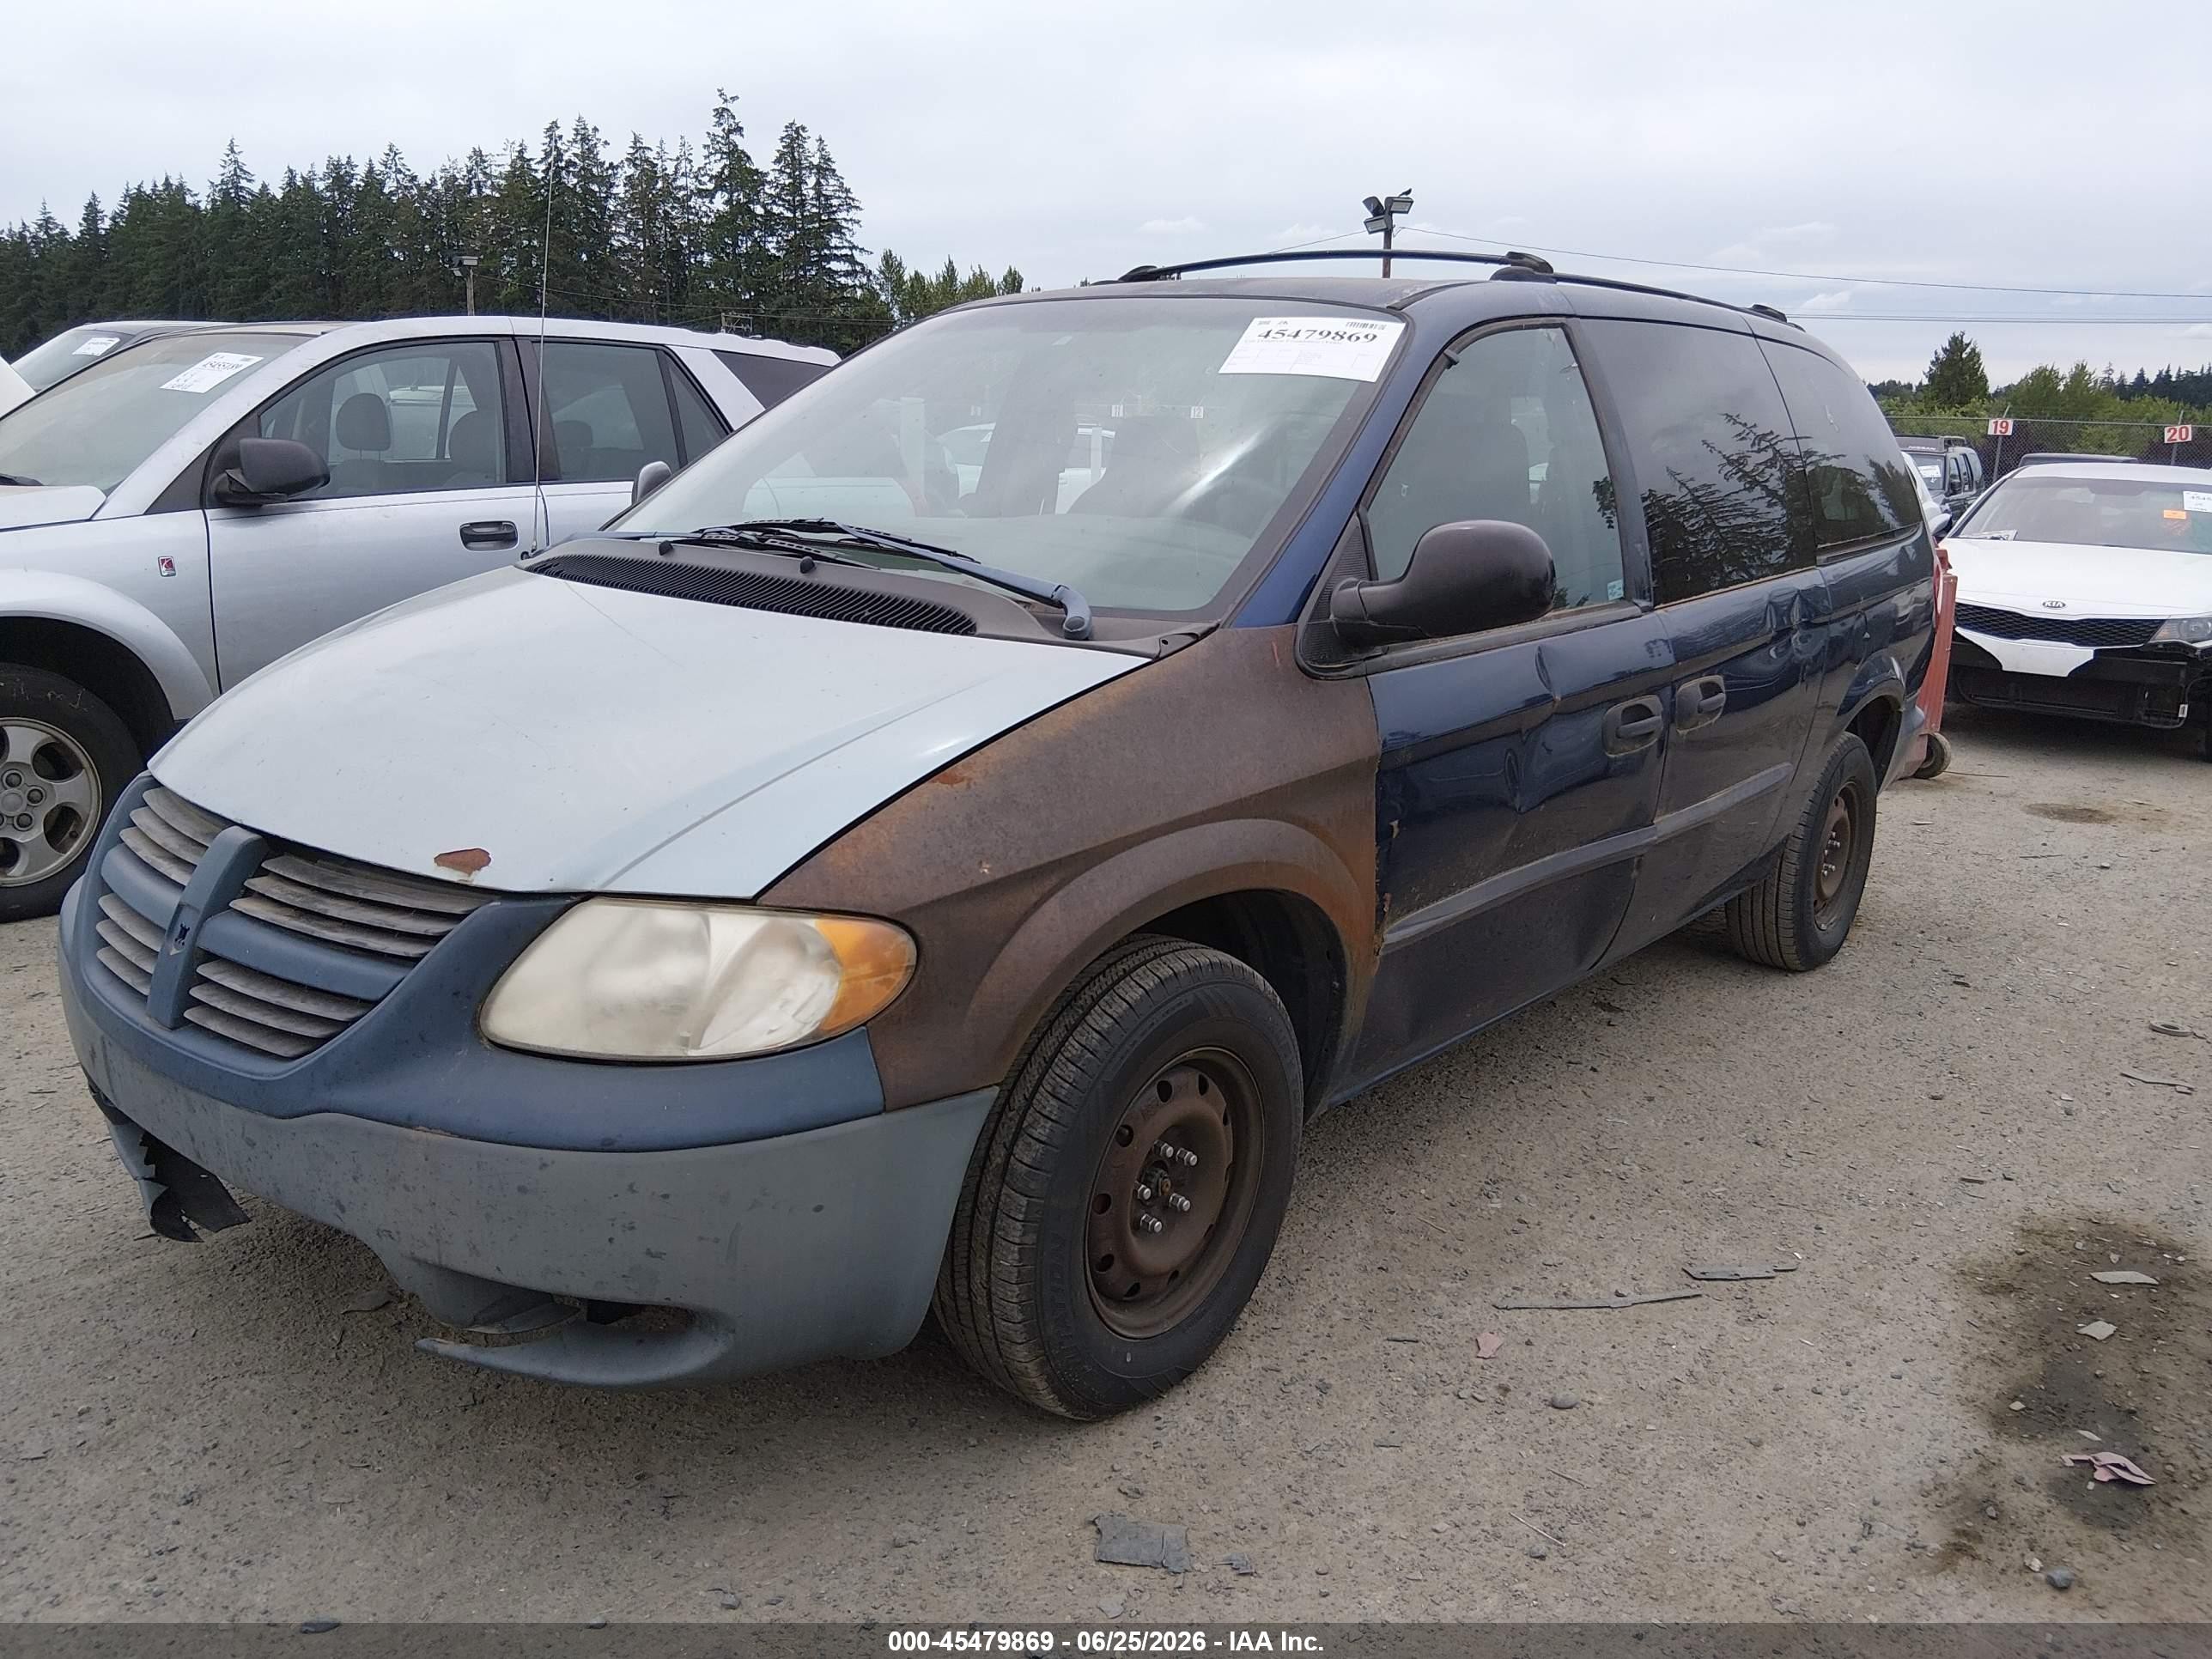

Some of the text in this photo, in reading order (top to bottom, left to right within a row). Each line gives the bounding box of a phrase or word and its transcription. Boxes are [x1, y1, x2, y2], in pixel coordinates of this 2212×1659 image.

[1257, 328, 1377, 343] 45479869
[1991, 420, 2009, 434] 19
[2166, 426, 2189, 442] 20
